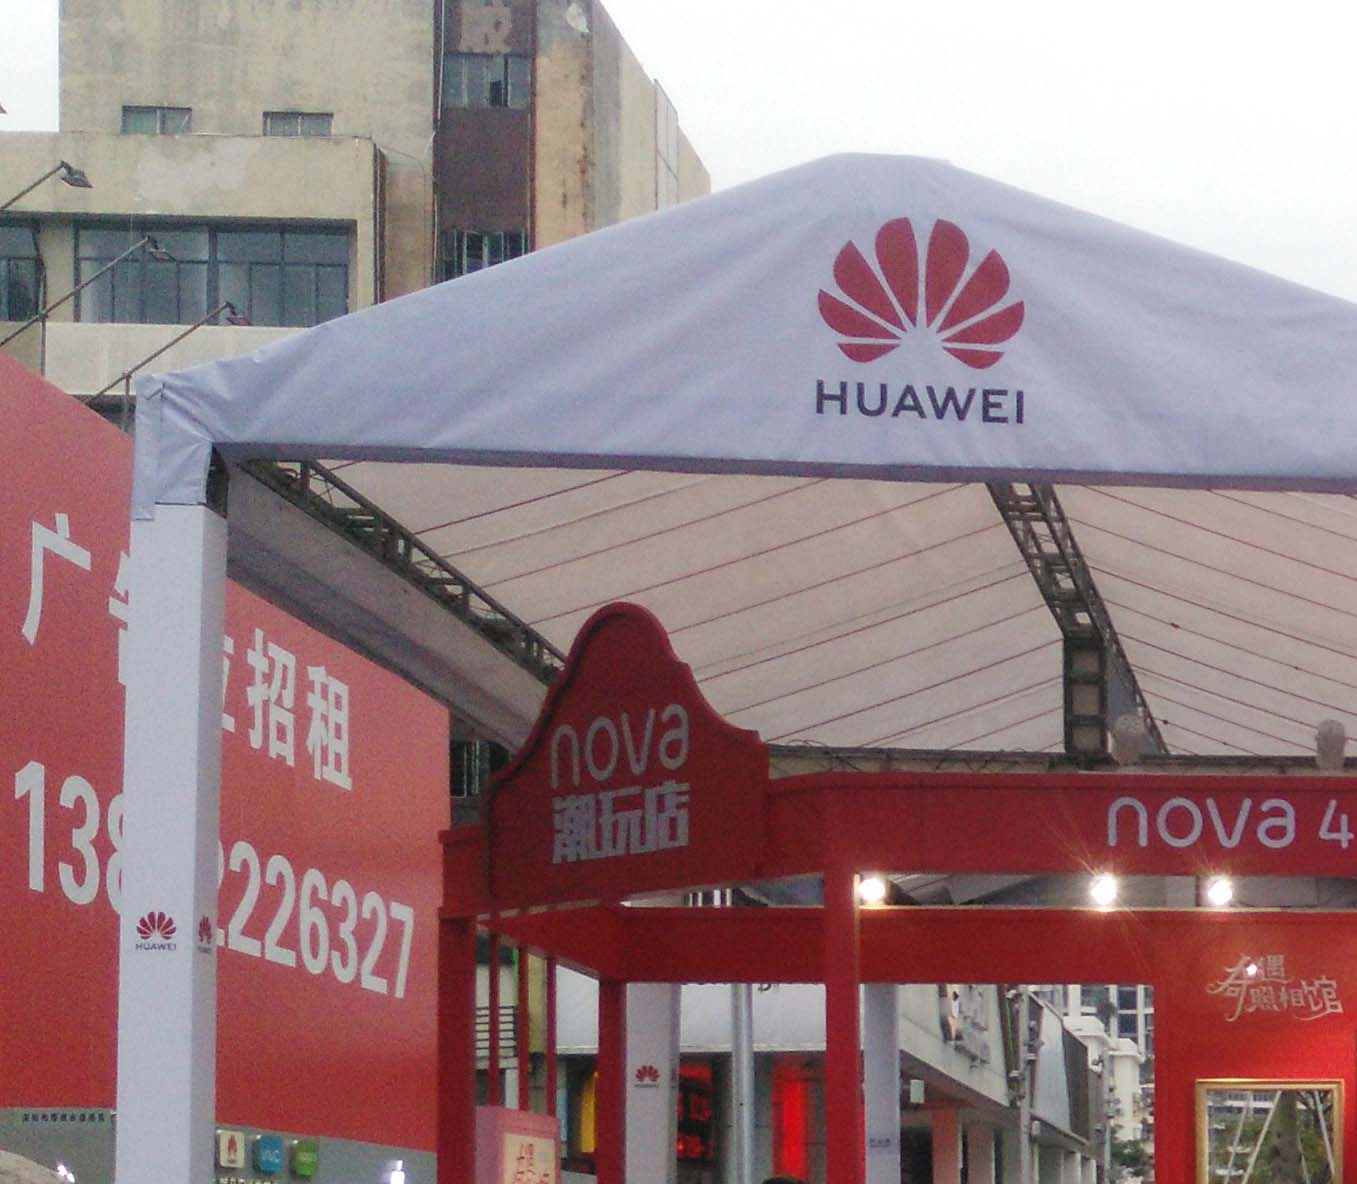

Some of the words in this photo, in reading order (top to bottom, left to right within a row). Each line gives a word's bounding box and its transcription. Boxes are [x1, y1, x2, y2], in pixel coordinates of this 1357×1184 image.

[815, 379, 1025, 425] HUAWEI
[550, 703, 689, 790] nova
[1107, 797, 1296, 849] nova
[1318, 799, 1354, 849] 4
[135, 943, 177, 952] HUAWEI
